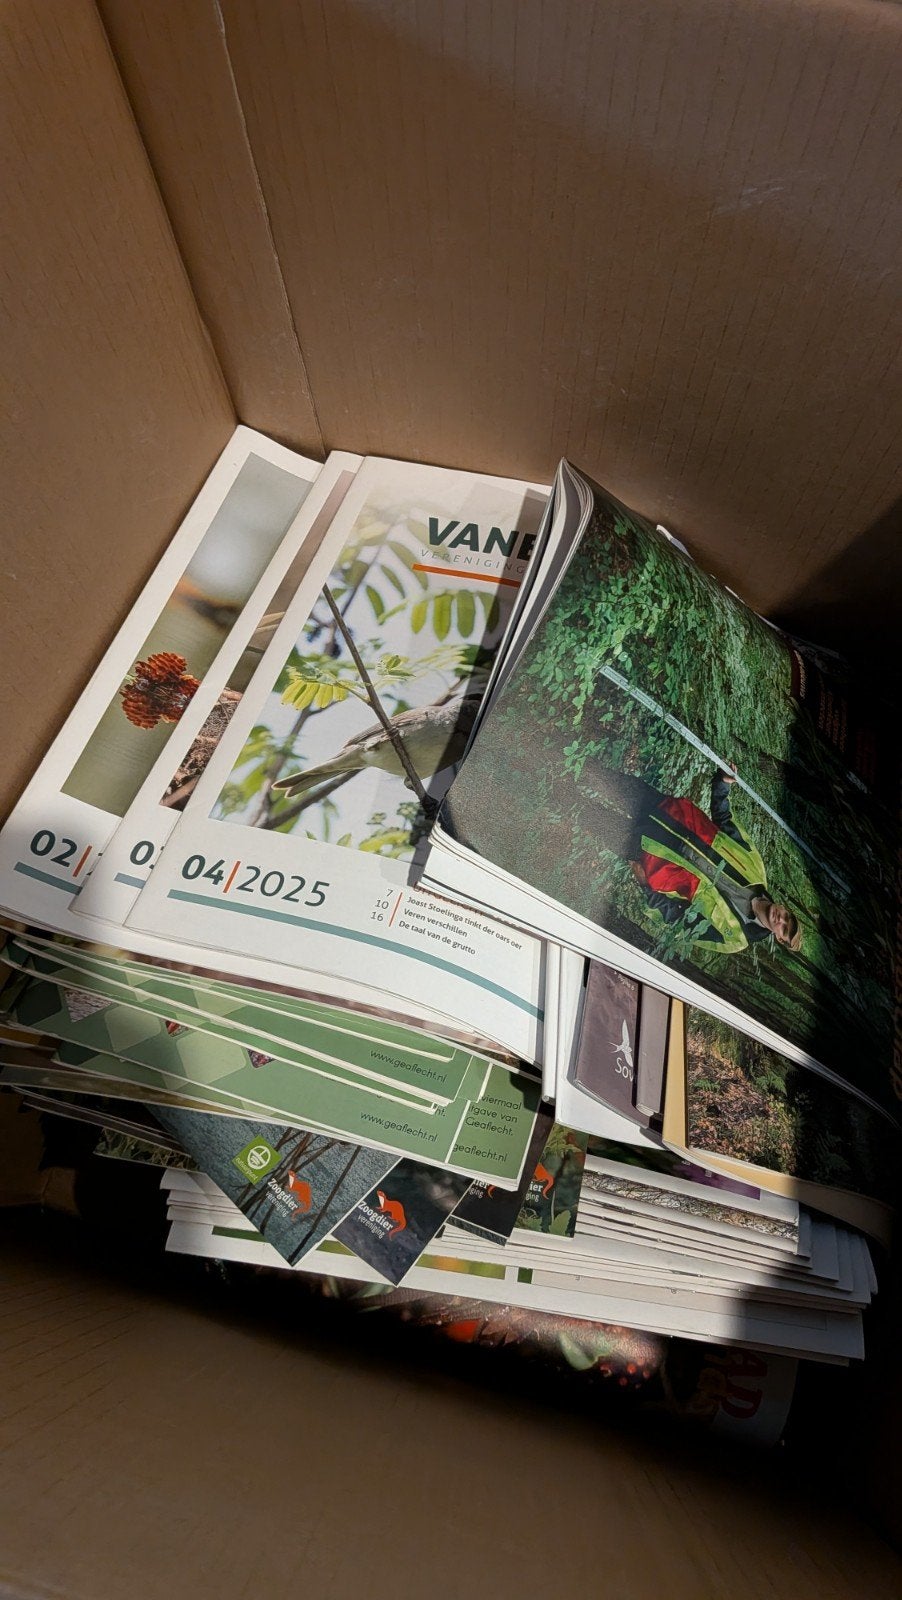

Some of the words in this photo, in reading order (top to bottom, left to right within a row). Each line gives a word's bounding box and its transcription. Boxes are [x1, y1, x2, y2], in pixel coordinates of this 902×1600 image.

[130, 840, 165, 870] 0
[370, 911, 384, 922] 16
[398, 920, 410, 929] De
[411, 924, 426, 935] taal
[427, 930, 441, 941] van
[441, 936, 452, 945] de
[452, 941, 476, 955] grutto
[375, 899, 389, 910] 10
[404, 908, 426, 921] Veren
[427, 917, 468, 938] verschillen
[386, 889, 394, 897] 7
[428, 903, 464, 922] Stoelinga
[465, 917, 482, 930] tinkt
[483, 925, 495, 935] der
[495, 933, 510, 944] oars
[510, 940, 523, 950] oer
[370, 1049, 448, 1083] www.geaflecht.nl
[360, 1111, 439, 1143] www.geaflecht.nl
[465, 1116, 513, 1136] Geaflecht.
[468, 1104, 498, 1118] itgave
[500, 1113, 518, 1123] van
[267, 1177, 299, 1210] Zoogdier
[357, 1200, 394, 1231] Zoogdier
